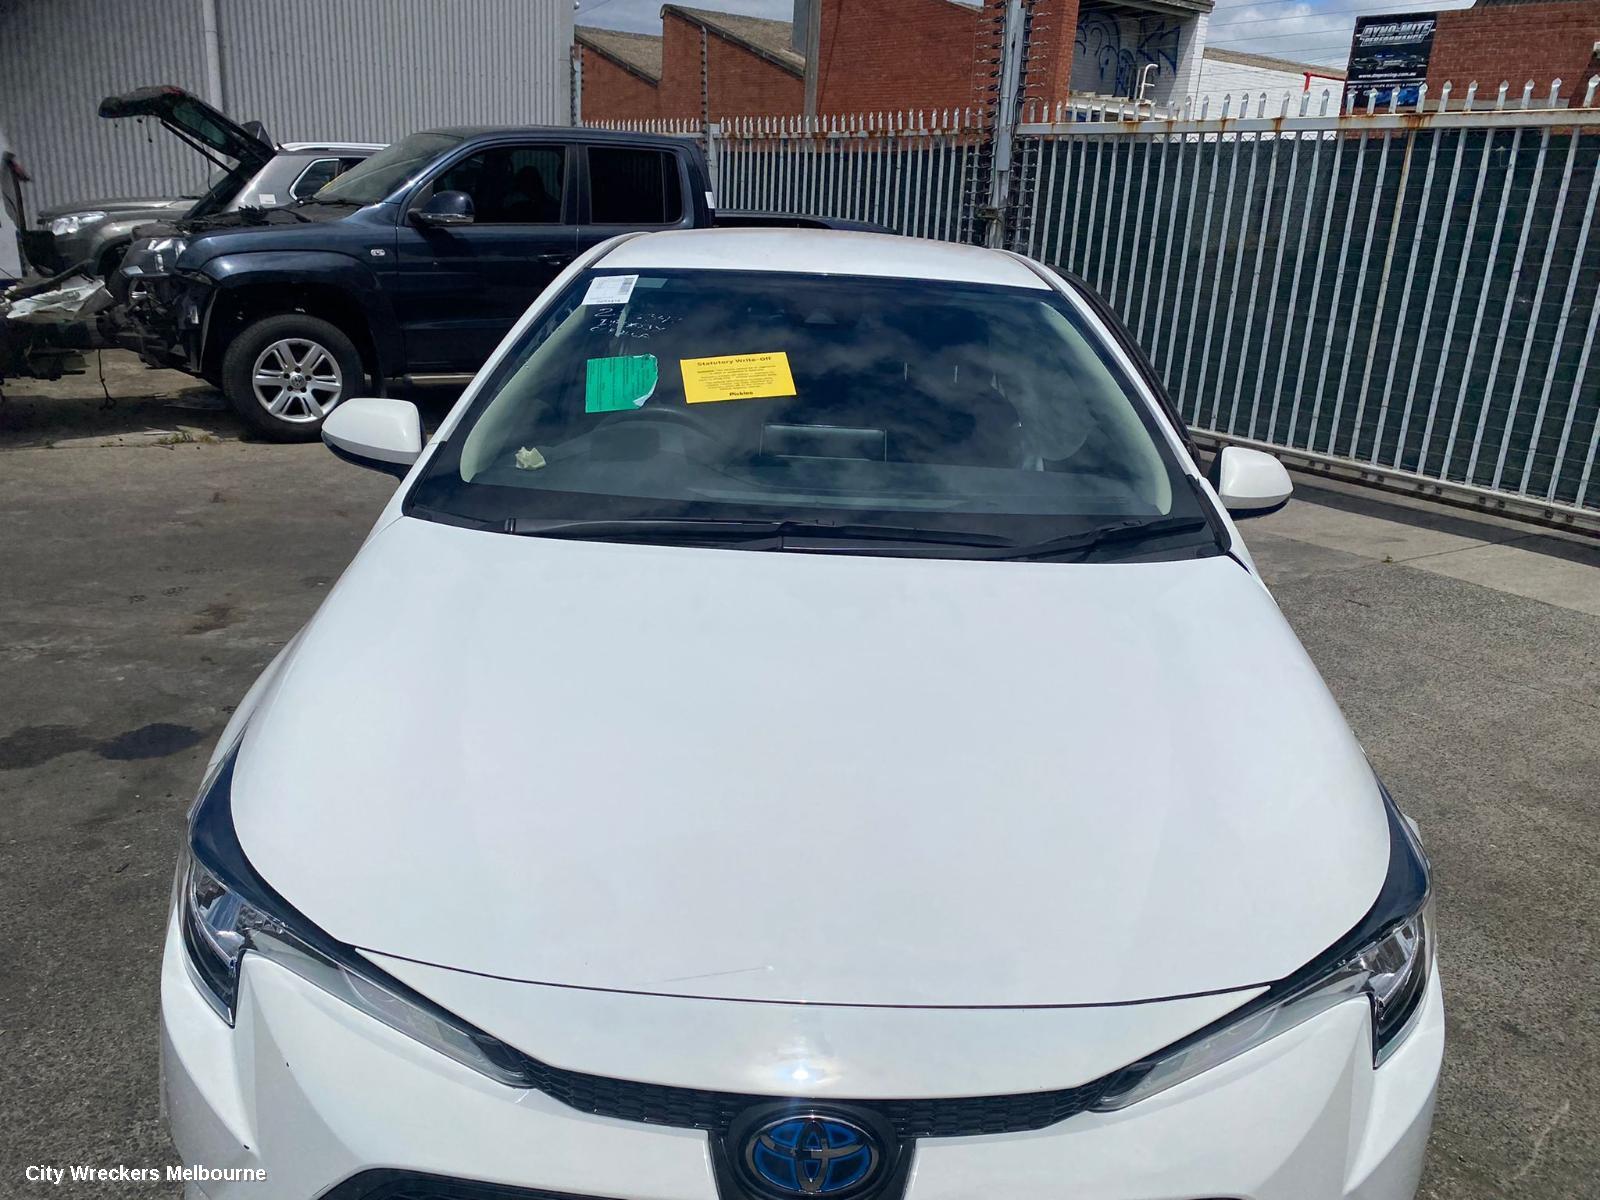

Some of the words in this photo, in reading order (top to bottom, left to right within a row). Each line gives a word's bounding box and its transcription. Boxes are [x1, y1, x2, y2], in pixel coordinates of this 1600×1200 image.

[1363, 23, 1432, 37] DYNO-MITE
[1364, 34, 1424, 43] PERFORMANCE
[697, 359, 734, 367] Statutory
